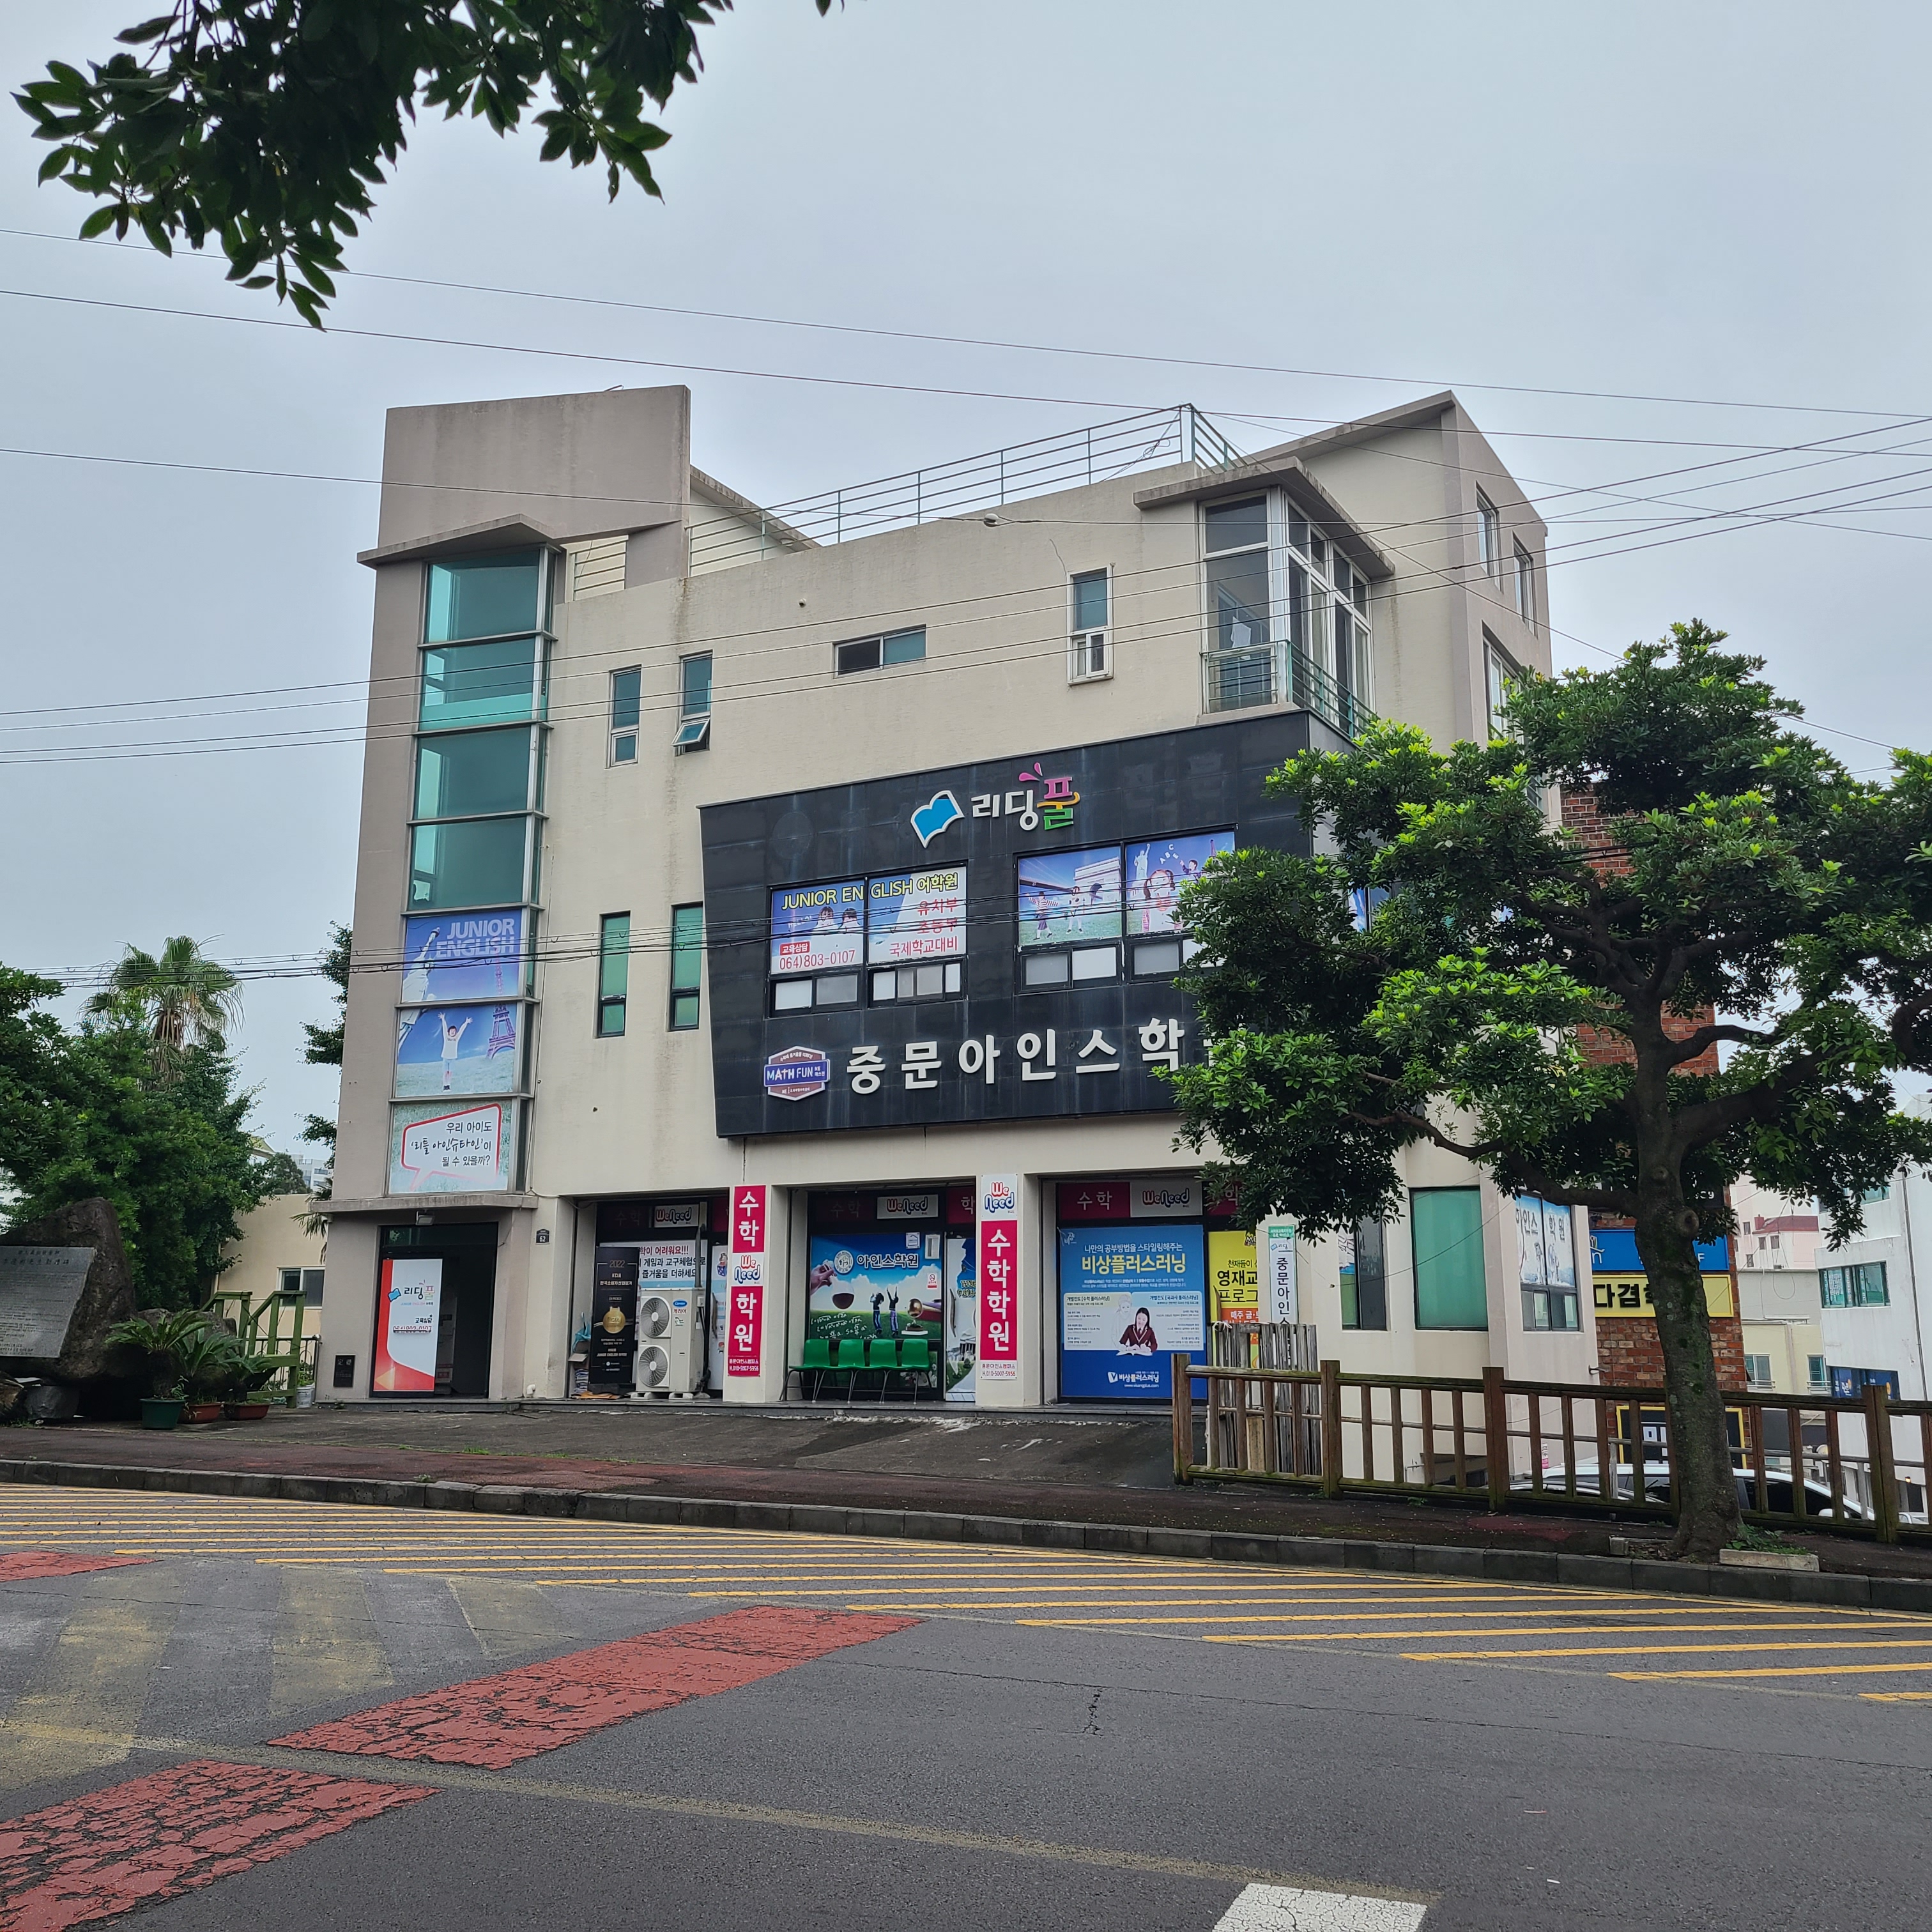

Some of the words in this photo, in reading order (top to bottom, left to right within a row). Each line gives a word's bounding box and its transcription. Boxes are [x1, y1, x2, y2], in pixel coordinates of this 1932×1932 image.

[971, 777, 1080, 831] 리딩풀
[782, 889, 838, 910] JUNIOR
[916, 873, 958, 893] 어학원
[917, 897, 958, 916] 유치부
[447, 918, 515, 939] JUNIOR
[917, 917, 958, 935] 초등부
[436, 936, 514, 958] ENGLISH
[782, 942, 809, 954] 교육상담
[889, 935, 958, 958] 국제학교대비
[779, 949, 855, 970] 064)803-0107
[767, 1068, 795, 1081] MATH
[796, 1066, 813, 1078] FUN
[446, 1122, 463, 1134] 우리
[466, 1121, 493, 1133] 아이도
[441, 1157, 450, 1167] 될
[452, 1156, 461, 1167] 수
[463, 1154, 491, 1167] 있을까?
[1077, 1190, 1112, 1211] 수학
[739, 1191, 759, 1247] 수학
[655, 1245, 689, 1255] 어려워요!!!
[1084, 1244, 1103, 1254] 나만의
[1104, 1243, 1137, 1253] 공부방법을
[1137, 1242, 1183, 1252] 스타일링해주는
[610, 1260, 625, 1268] 2022
[643, 1257, 664, 1267] 게임과
[857, 1254, 919, 1269] 아인스학원
[1082, 1252, 1186, 1275] 비상플러스러닝
[1227, 1259, 1253, 1268] 천재들이
[641, 1269, 668, 1278] 즐거움을
[404, 1285, 436, 1301] 리딩풀
[733, 1292, 756, 1351] 학원
[1119, 1374, 1160, 1383] 비상플러스러닝
